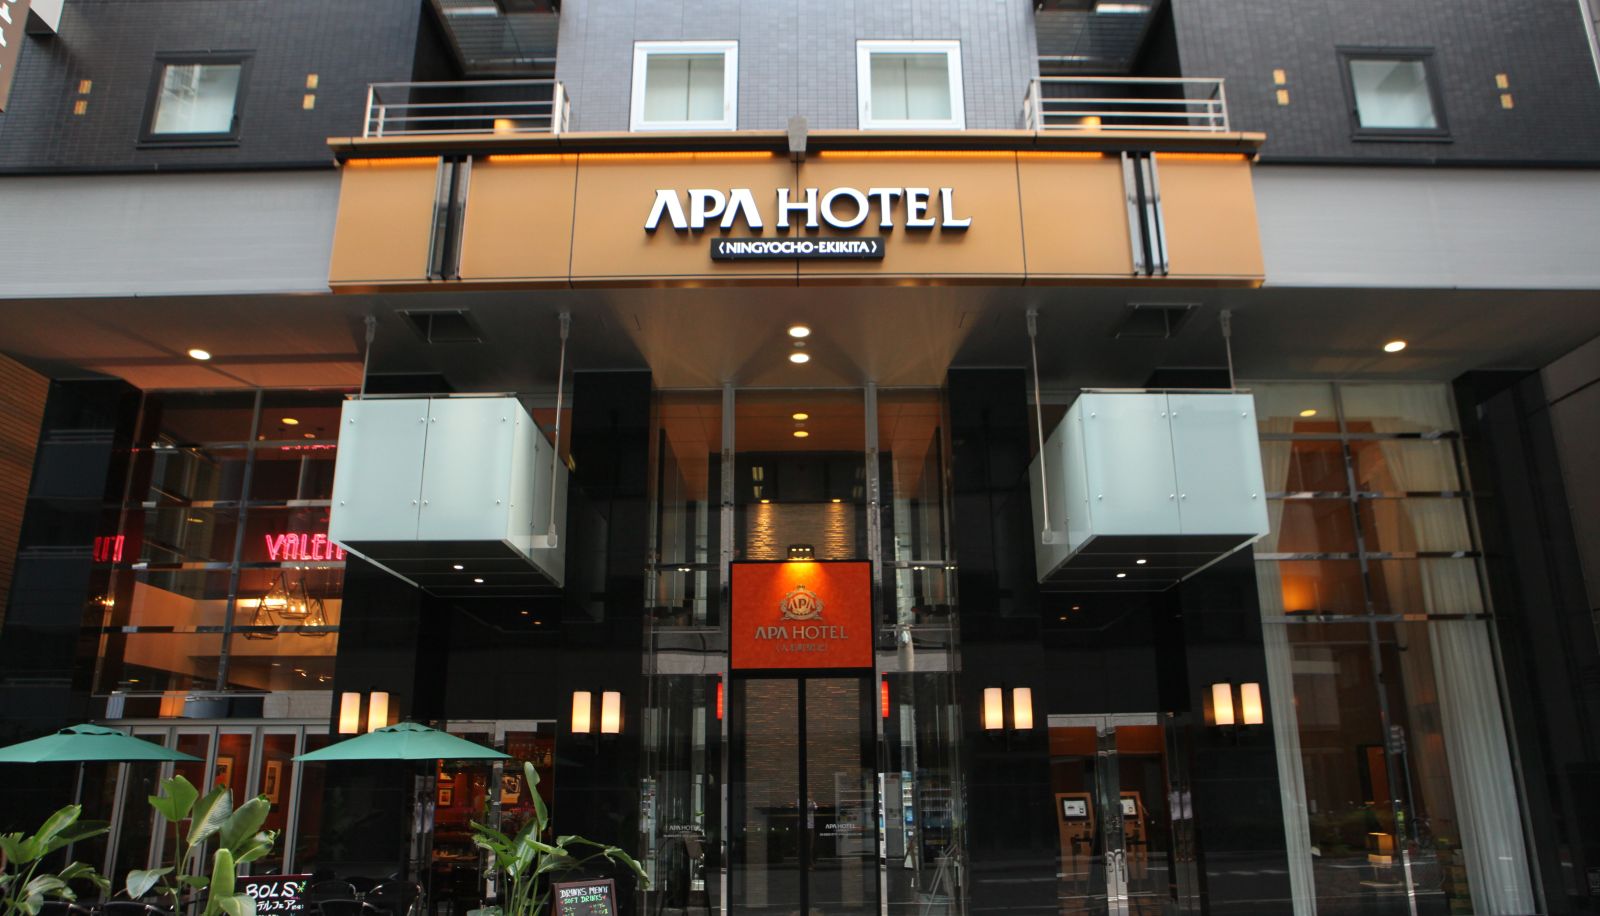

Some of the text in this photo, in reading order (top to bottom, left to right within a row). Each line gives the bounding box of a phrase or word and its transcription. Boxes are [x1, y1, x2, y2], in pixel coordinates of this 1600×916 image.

[644, 187, 972, 231] APA HOTEL
[788, 598, 816, 609] APA
[755, 625, 848, 640] APA HOTEL
[246, 882, 298, 899] BOLS
[560, 888, 587, 898] DRINKS
[564, 894, 603, 904] SOFT DRINKS
